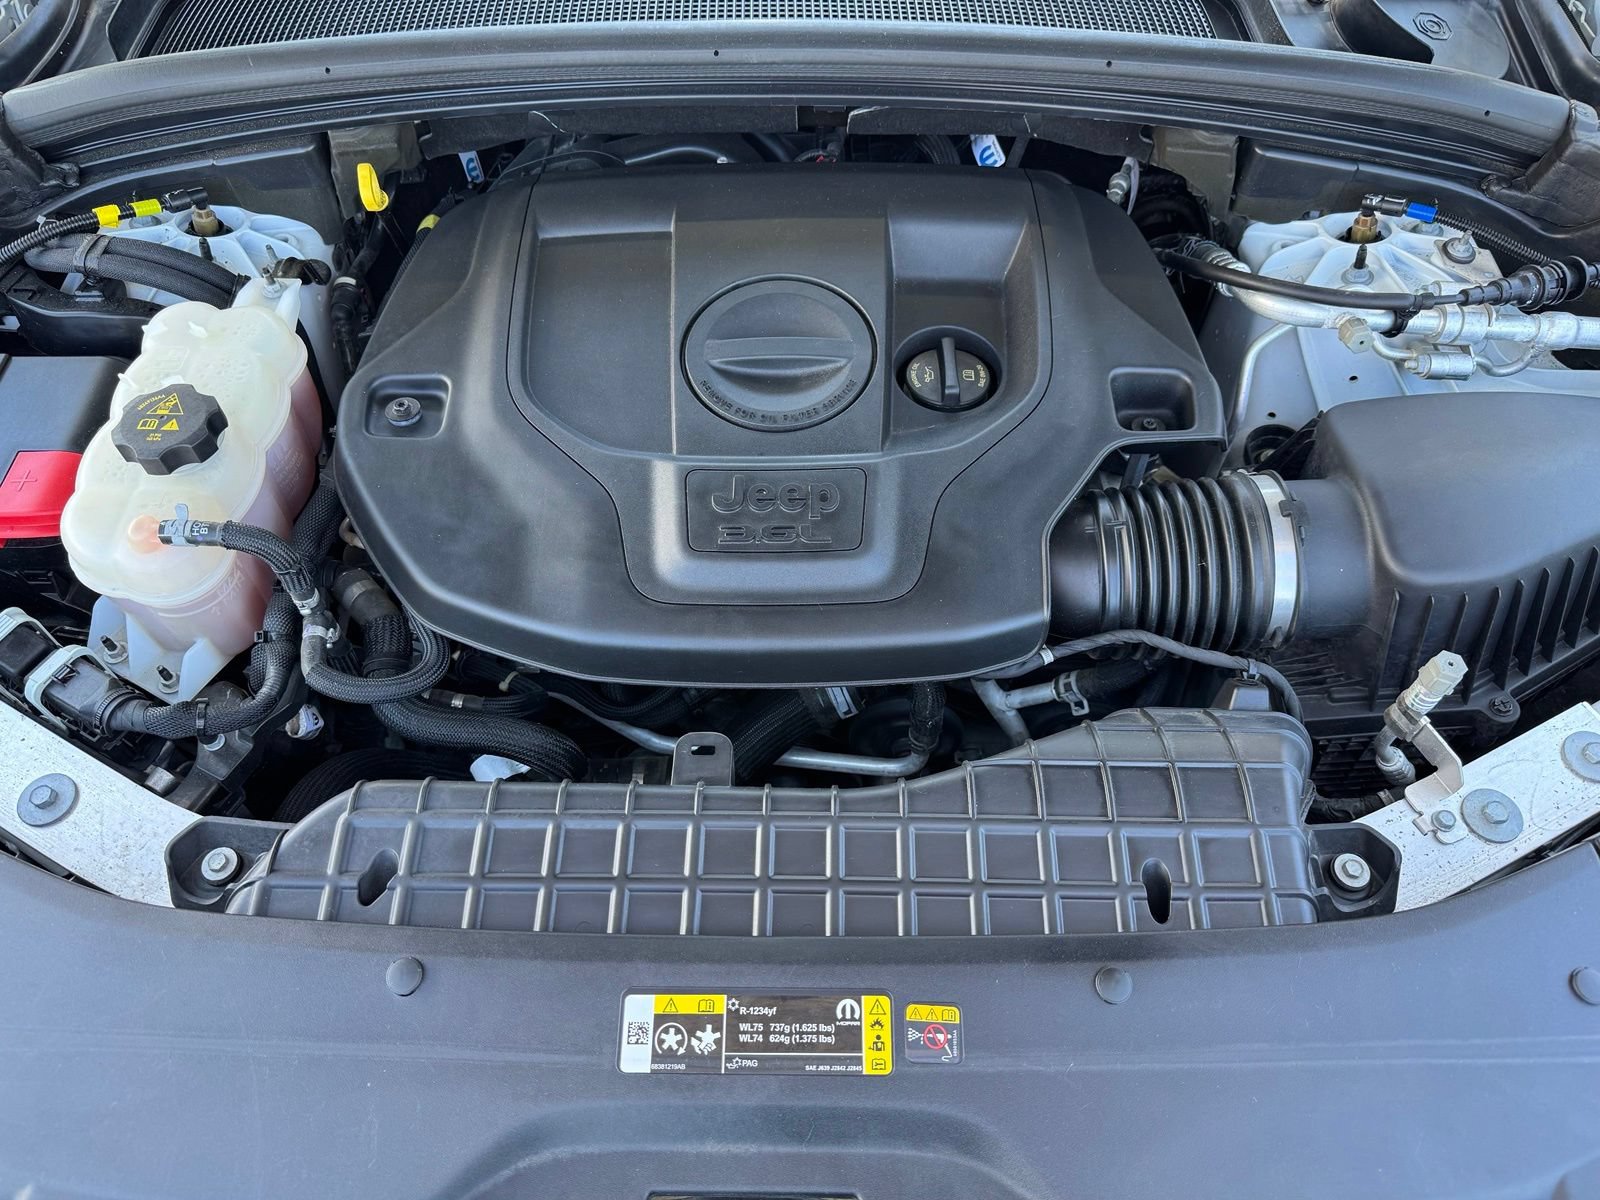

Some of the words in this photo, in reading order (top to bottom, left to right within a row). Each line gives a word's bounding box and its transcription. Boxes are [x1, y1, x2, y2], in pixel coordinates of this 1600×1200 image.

[911, 362, 921, 370] OIL
[910, 370, 922, 388] ENGINE
[699, 379, 733, 411] REMOVE
[734, 407, 756, 421] FOR
[760, 414, 778, 424] OIL
[782, 407, 820, 424] FILTER
[711, 475, 840, 519] Jeep
[717, 523, 832, 545] 3.6L
[739, 1006, 777, 1017] R-1234yf
[739, 1023, 764, 1031] WL75
[769, 1023, 791, 1033] 737g
[792, 1023, 817, 1033] (1.625
[819, 1023, 835, 1033] lbs)
[739, 1034, 763, 1043] WL74
[769, 1034, 791, 1044] 624g
[792, 1034, 817, 1044] (1.375
[819, 1034, 835, 1044] lbs)
